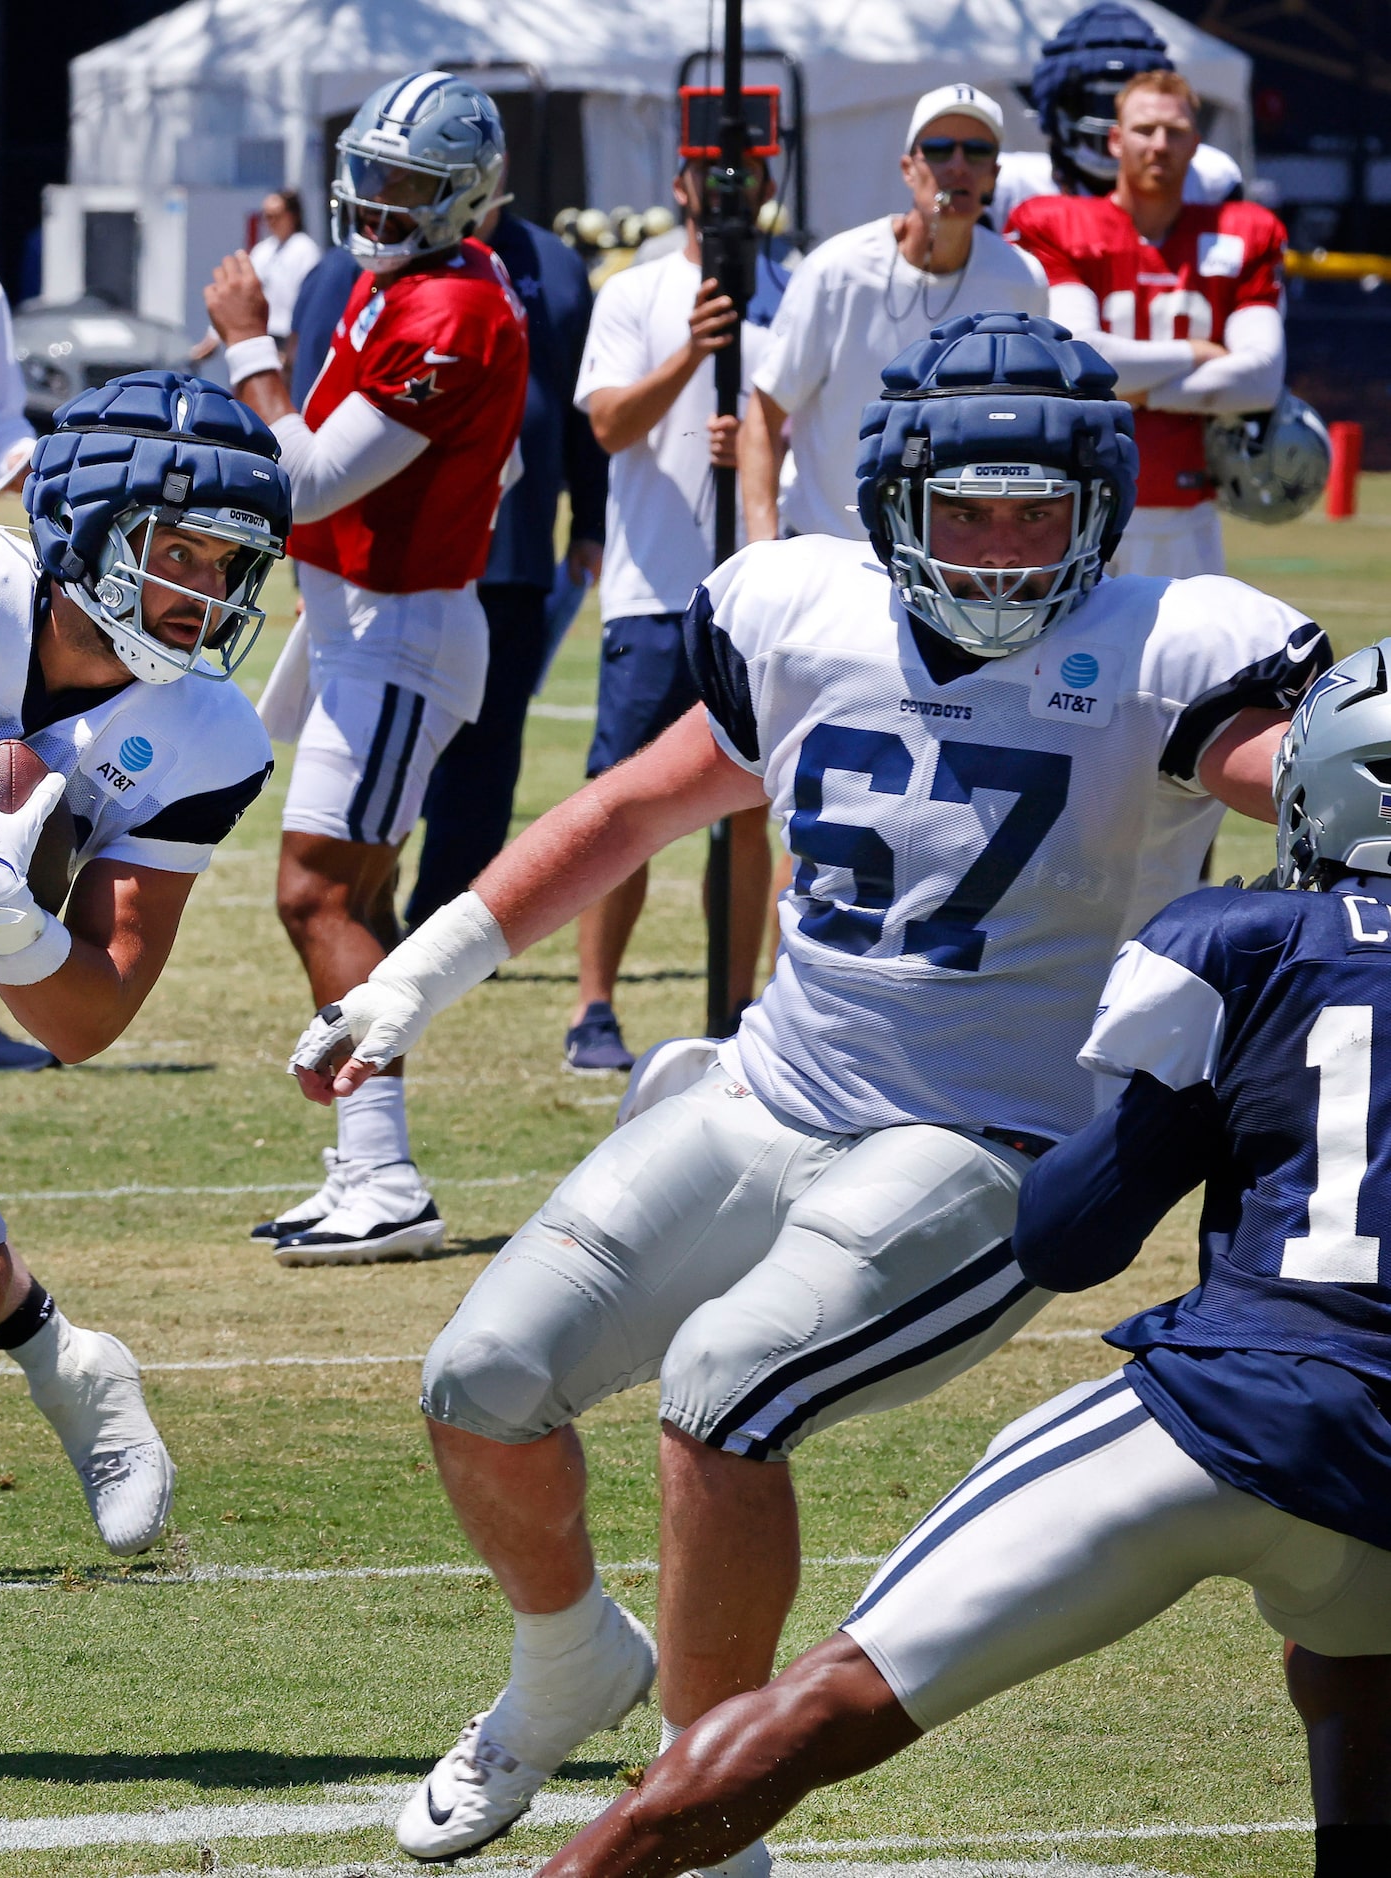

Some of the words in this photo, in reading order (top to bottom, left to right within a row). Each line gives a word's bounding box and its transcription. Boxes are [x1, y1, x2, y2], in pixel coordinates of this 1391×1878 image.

[975, 465, 1030, 477] COWBOYS
[899, 698, 973, 721] COWBOYS
[1047, 692, 1098, 715] AT&T
[96, 761, 136, 792] AT&T
[789, 722, 1073, 971] 67
[1342, 894, 1391, 943] C
[1279, 1005, 1381, 1284] 1
